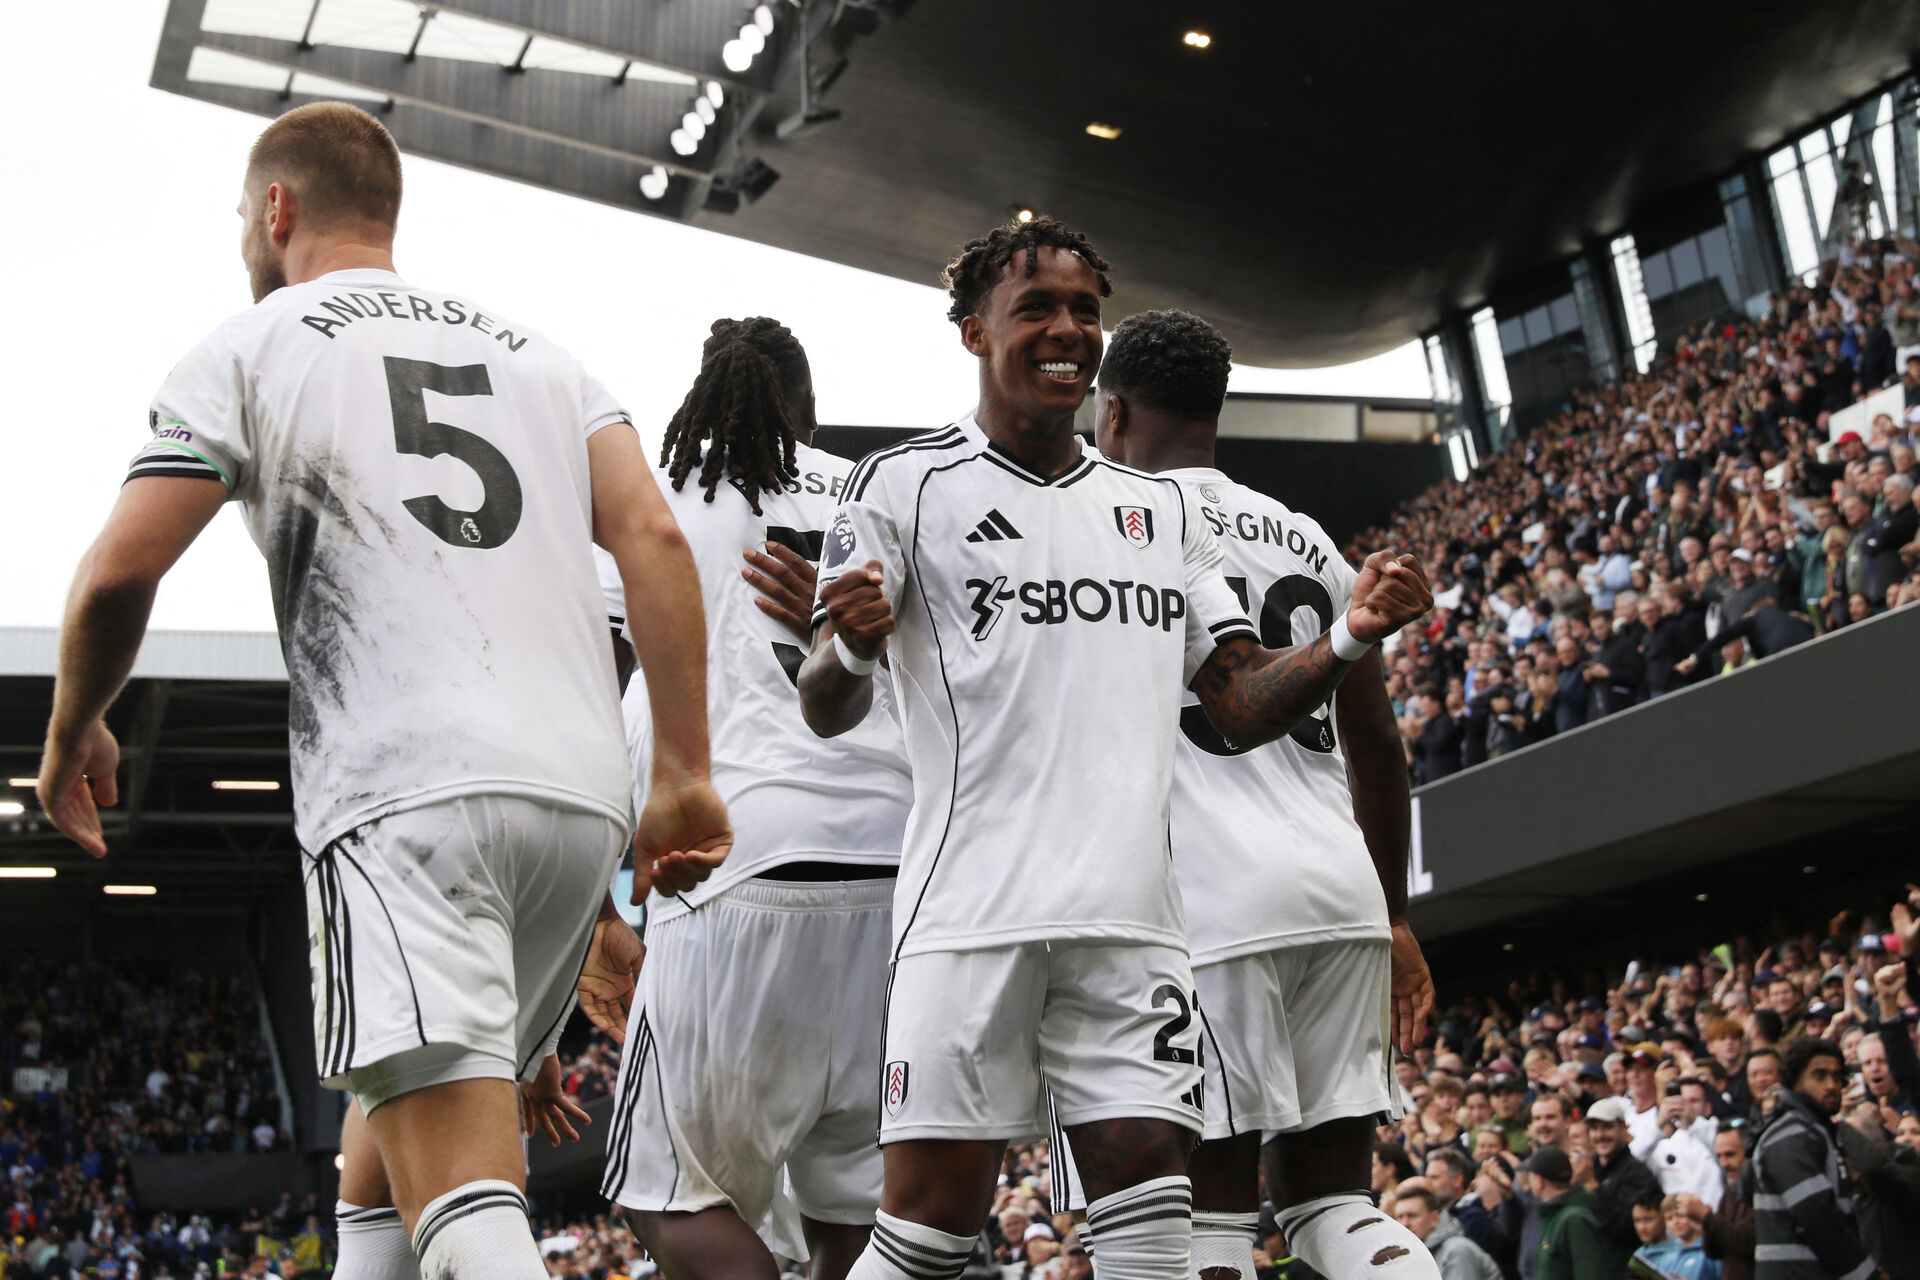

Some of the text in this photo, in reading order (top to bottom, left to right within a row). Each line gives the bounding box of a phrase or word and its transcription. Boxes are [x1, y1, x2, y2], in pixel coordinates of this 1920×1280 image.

[300, 292, 528, 353] ANDERSEN
[382, 355, 523, 550] 5
[1018, 577, 1185, 632] SBOTOP
